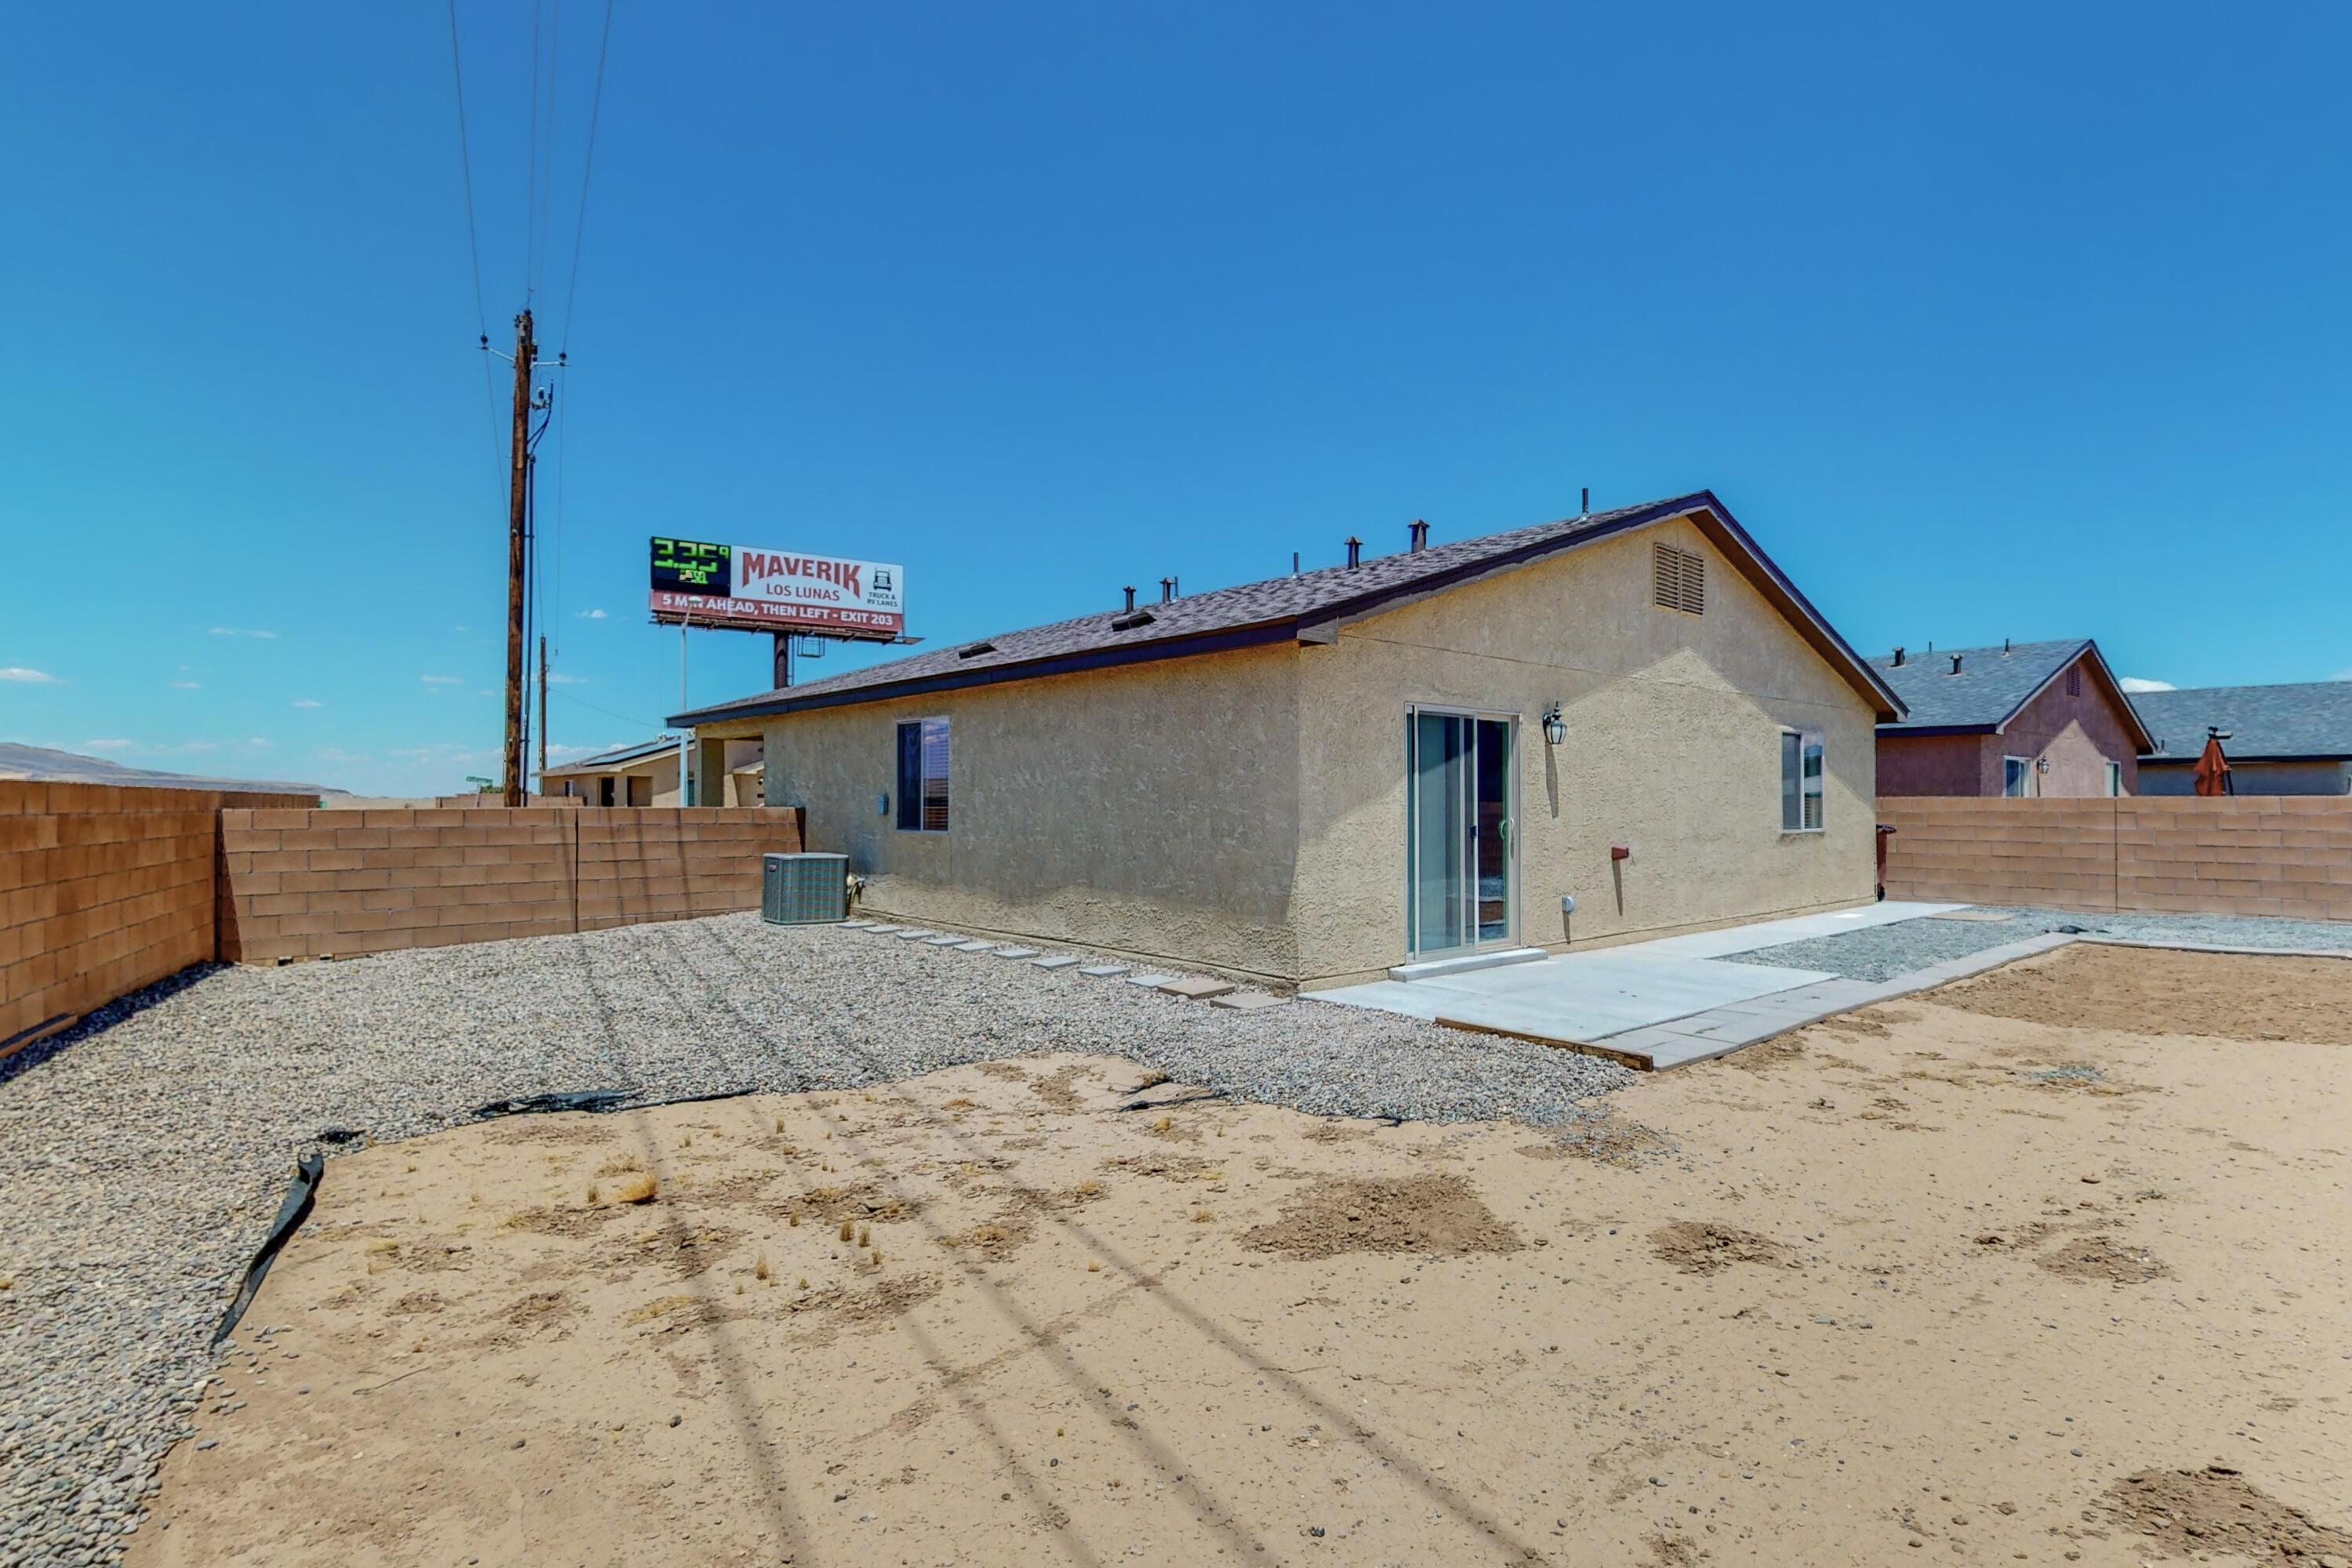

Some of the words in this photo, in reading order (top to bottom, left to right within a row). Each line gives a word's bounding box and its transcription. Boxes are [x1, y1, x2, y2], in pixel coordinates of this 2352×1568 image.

[742, 552, 861, 600] MAVERIK
[766, 583, 792, 597] LOS
[796, 586, 840, 601] LUNAS
[869, 591, 889, 600] TRUCK
[662, 594, 672, 605] 5
[674, 595, 704, 608] MN
[706, 598, 759, 615] AHEAD,
[761, 603, 797, 617] THEN
[800, 607, 830, 620] LEFT
[840, 611, 869, 622] EXIT
[871, 614, 893, 626] 203
